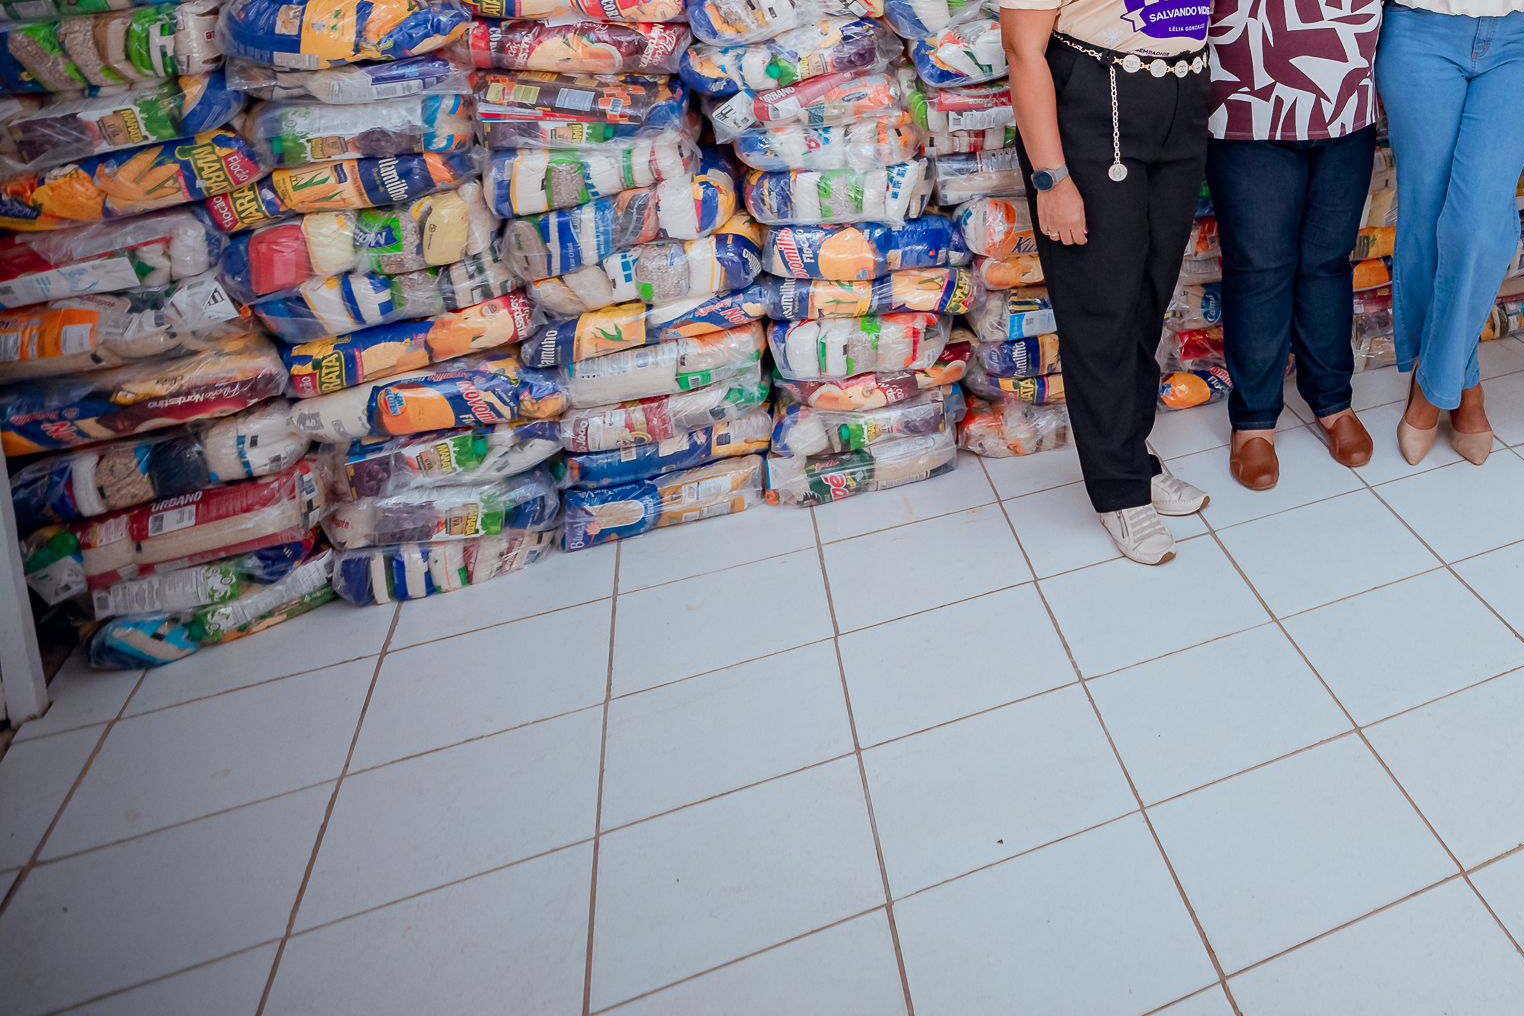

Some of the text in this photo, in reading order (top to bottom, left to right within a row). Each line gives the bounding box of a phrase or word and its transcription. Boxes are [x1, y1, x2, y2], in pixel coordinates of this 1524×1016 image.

[1149, 8, 1197, 22] SALVANDO
[227, 155, 251, 182] Flocão
[538, 329, 558, 368] tamilho
[321, 352, 343, 393] RATA
[151, 490, 203, 513] URBANO
